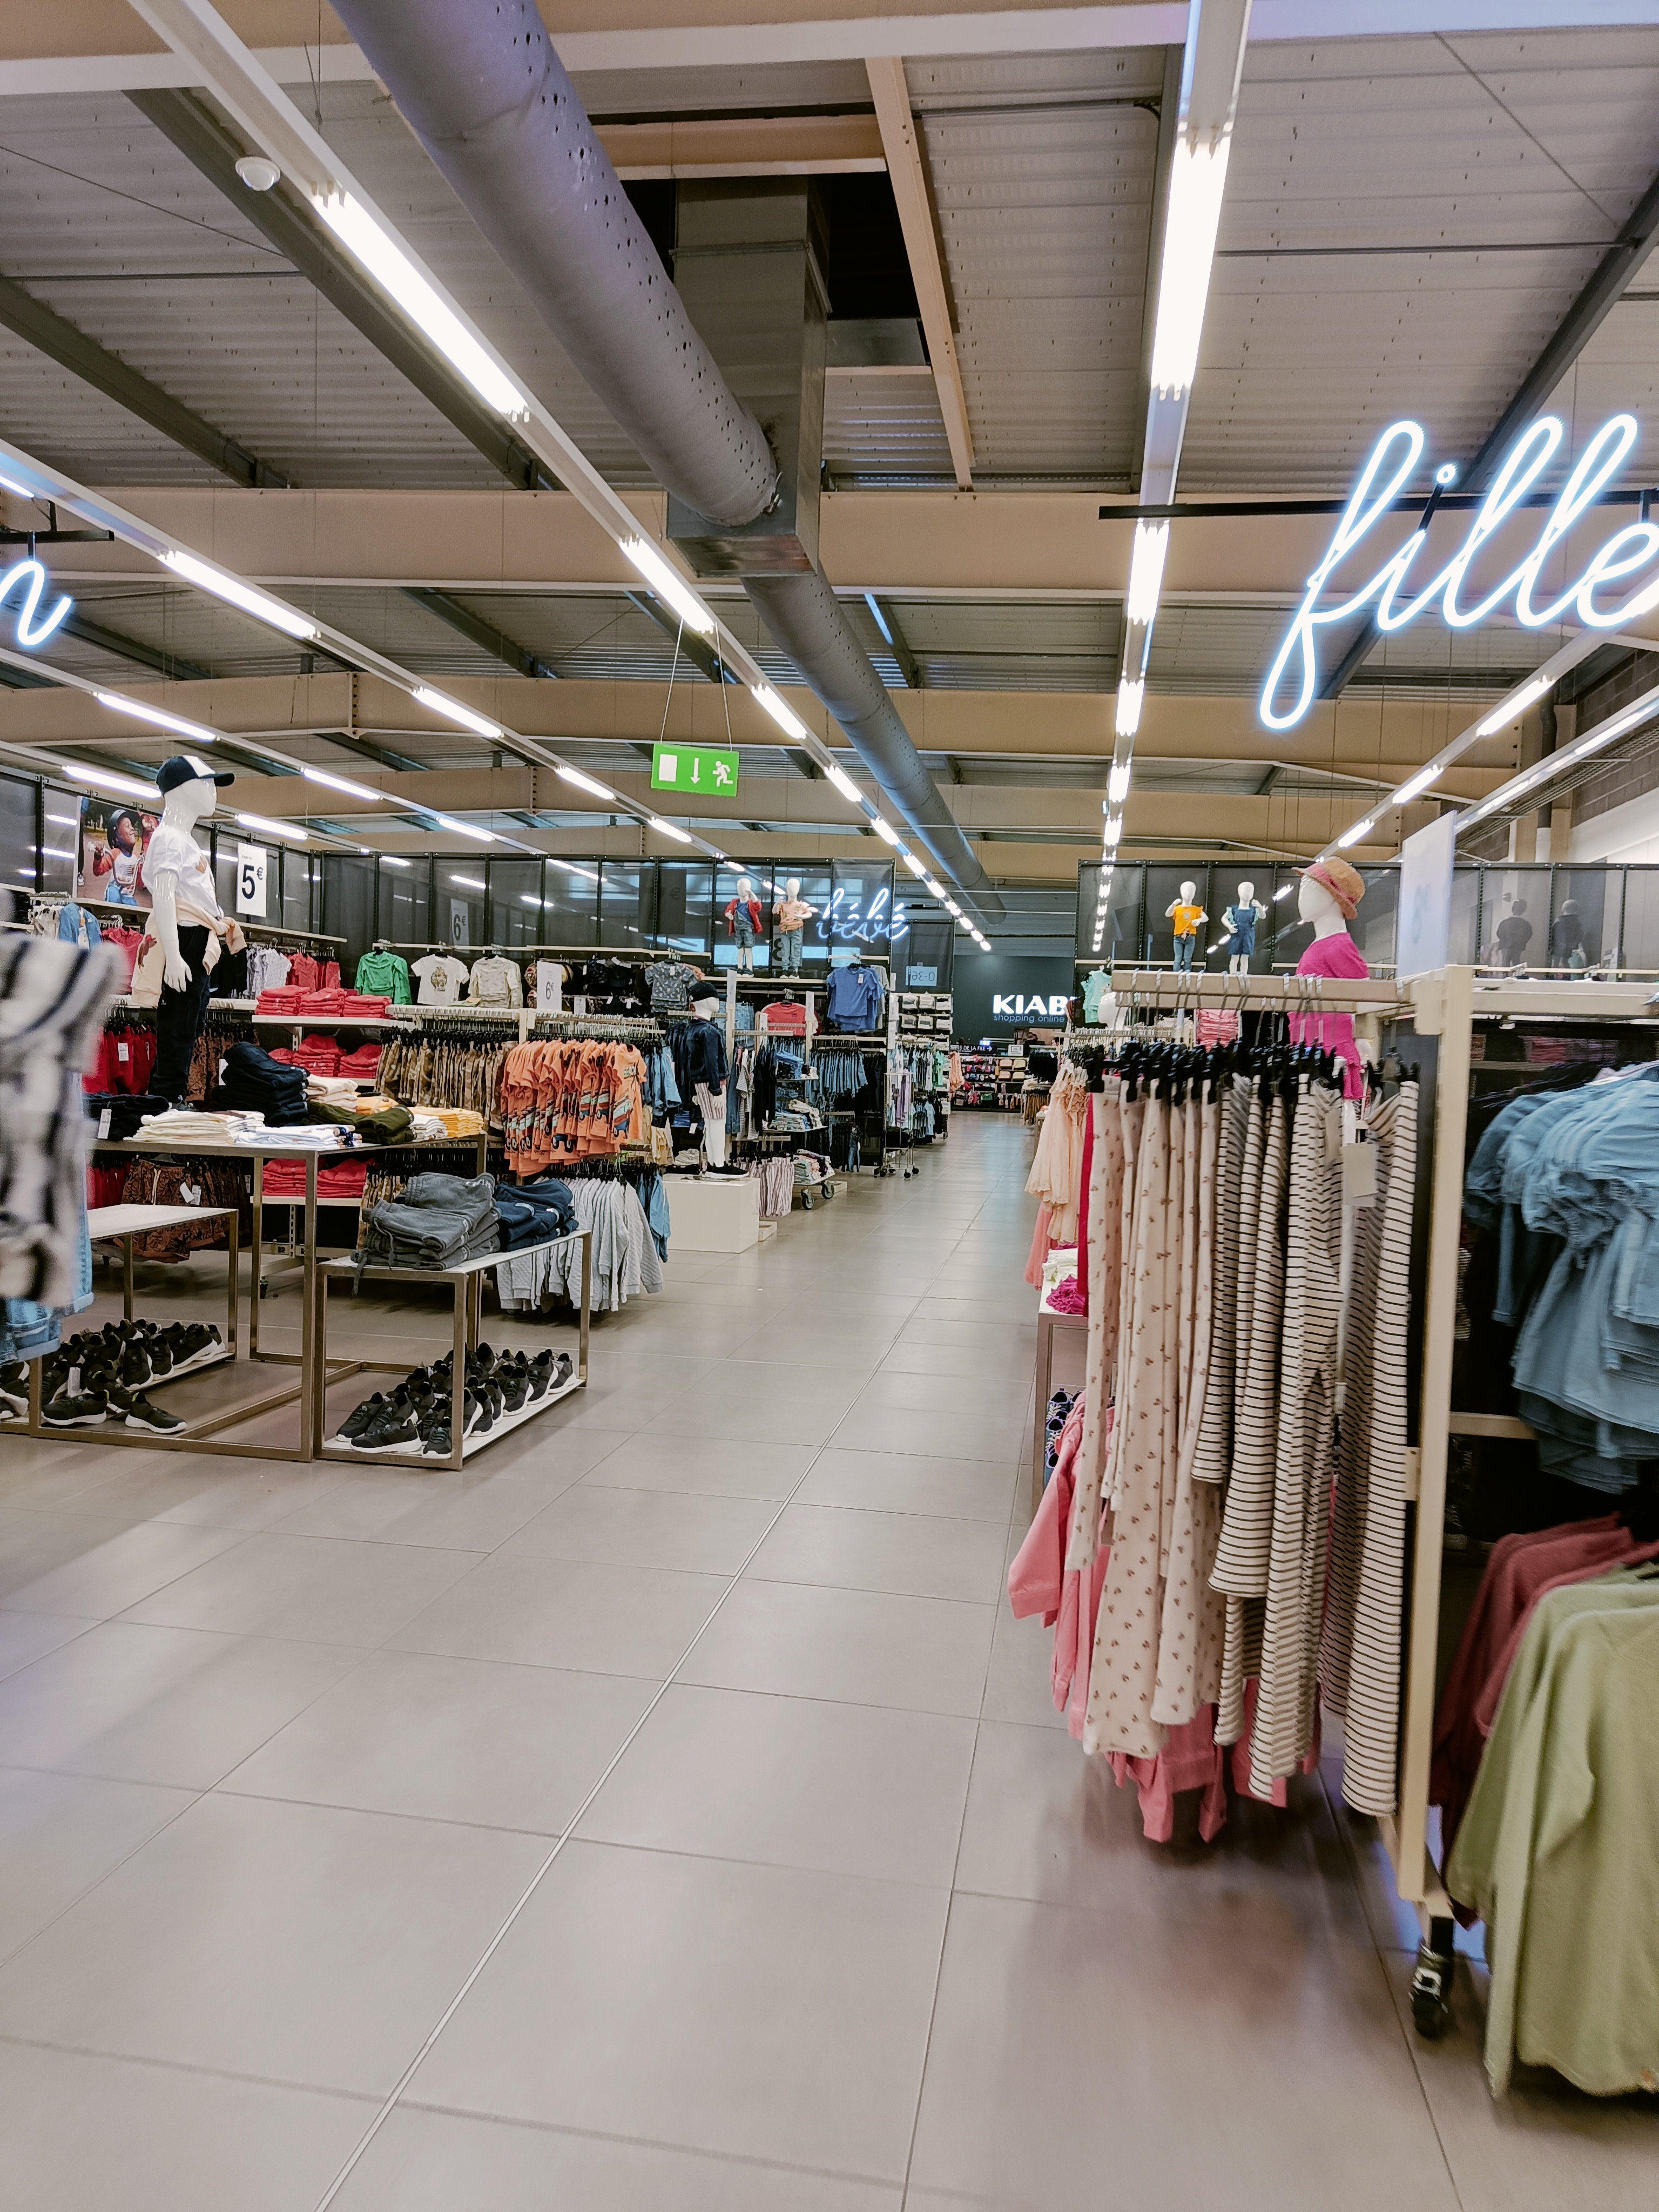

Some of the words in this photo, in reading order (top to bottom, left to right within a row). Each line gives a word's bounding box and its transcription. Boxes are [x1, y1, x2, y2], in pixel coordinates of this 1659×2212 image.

[1260, 415, 1659, 729] fille
[241, 864, 264, 900] 5€
[816, 887, 909, 941] bébé
[993, 994, 1075, 1015] KIAB
[994, 1014, 1035, 1023] shopping
